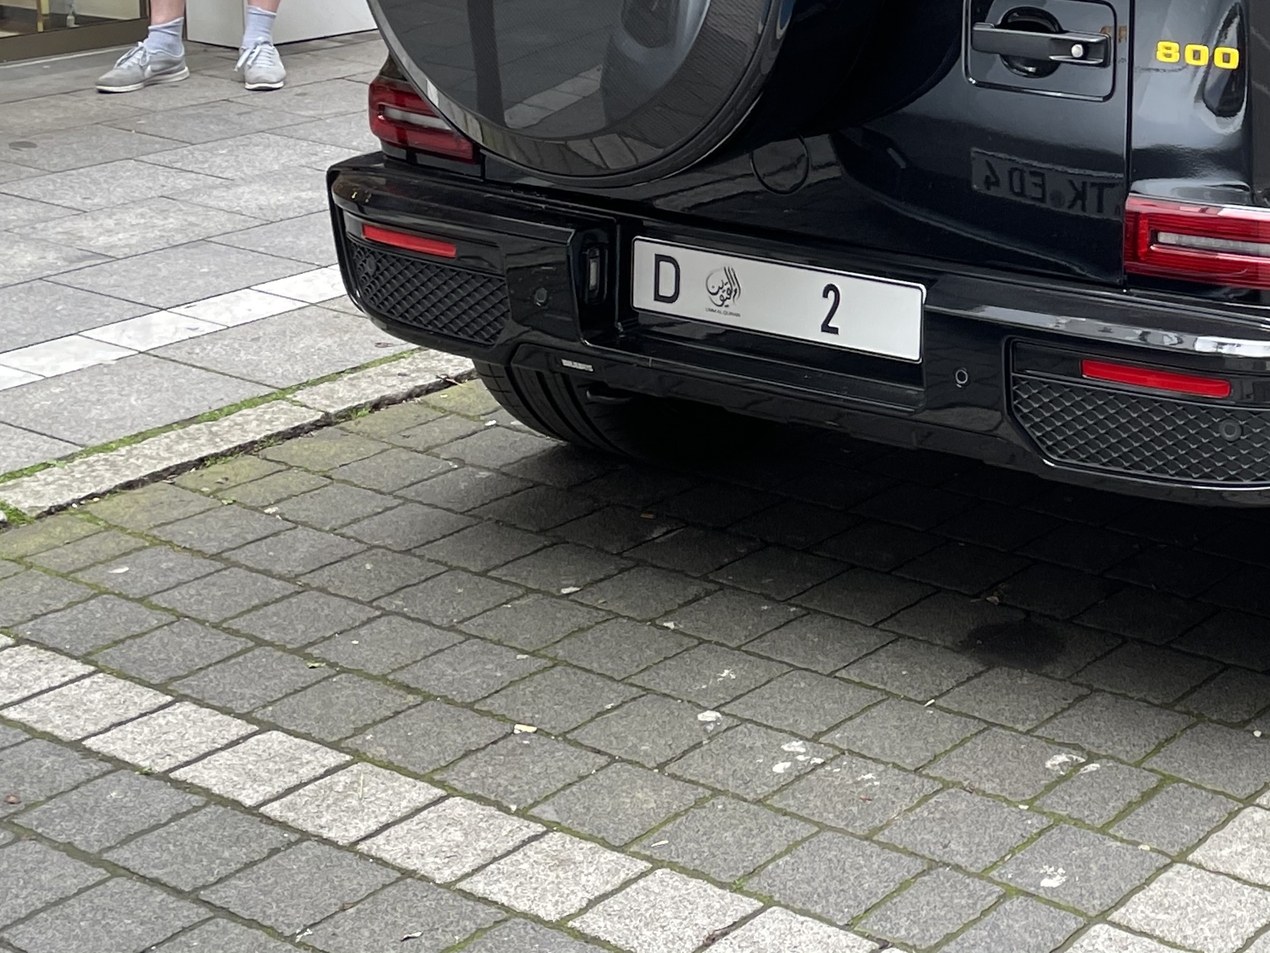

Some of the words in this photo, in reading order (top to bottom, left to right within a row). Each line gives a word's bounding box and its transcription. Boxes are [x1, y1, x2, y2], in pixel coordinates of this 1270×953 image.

[1156, 40, 1240, 70] 800
[653, 253, 681, 304] D
[820, 283, 841, 335] 2
